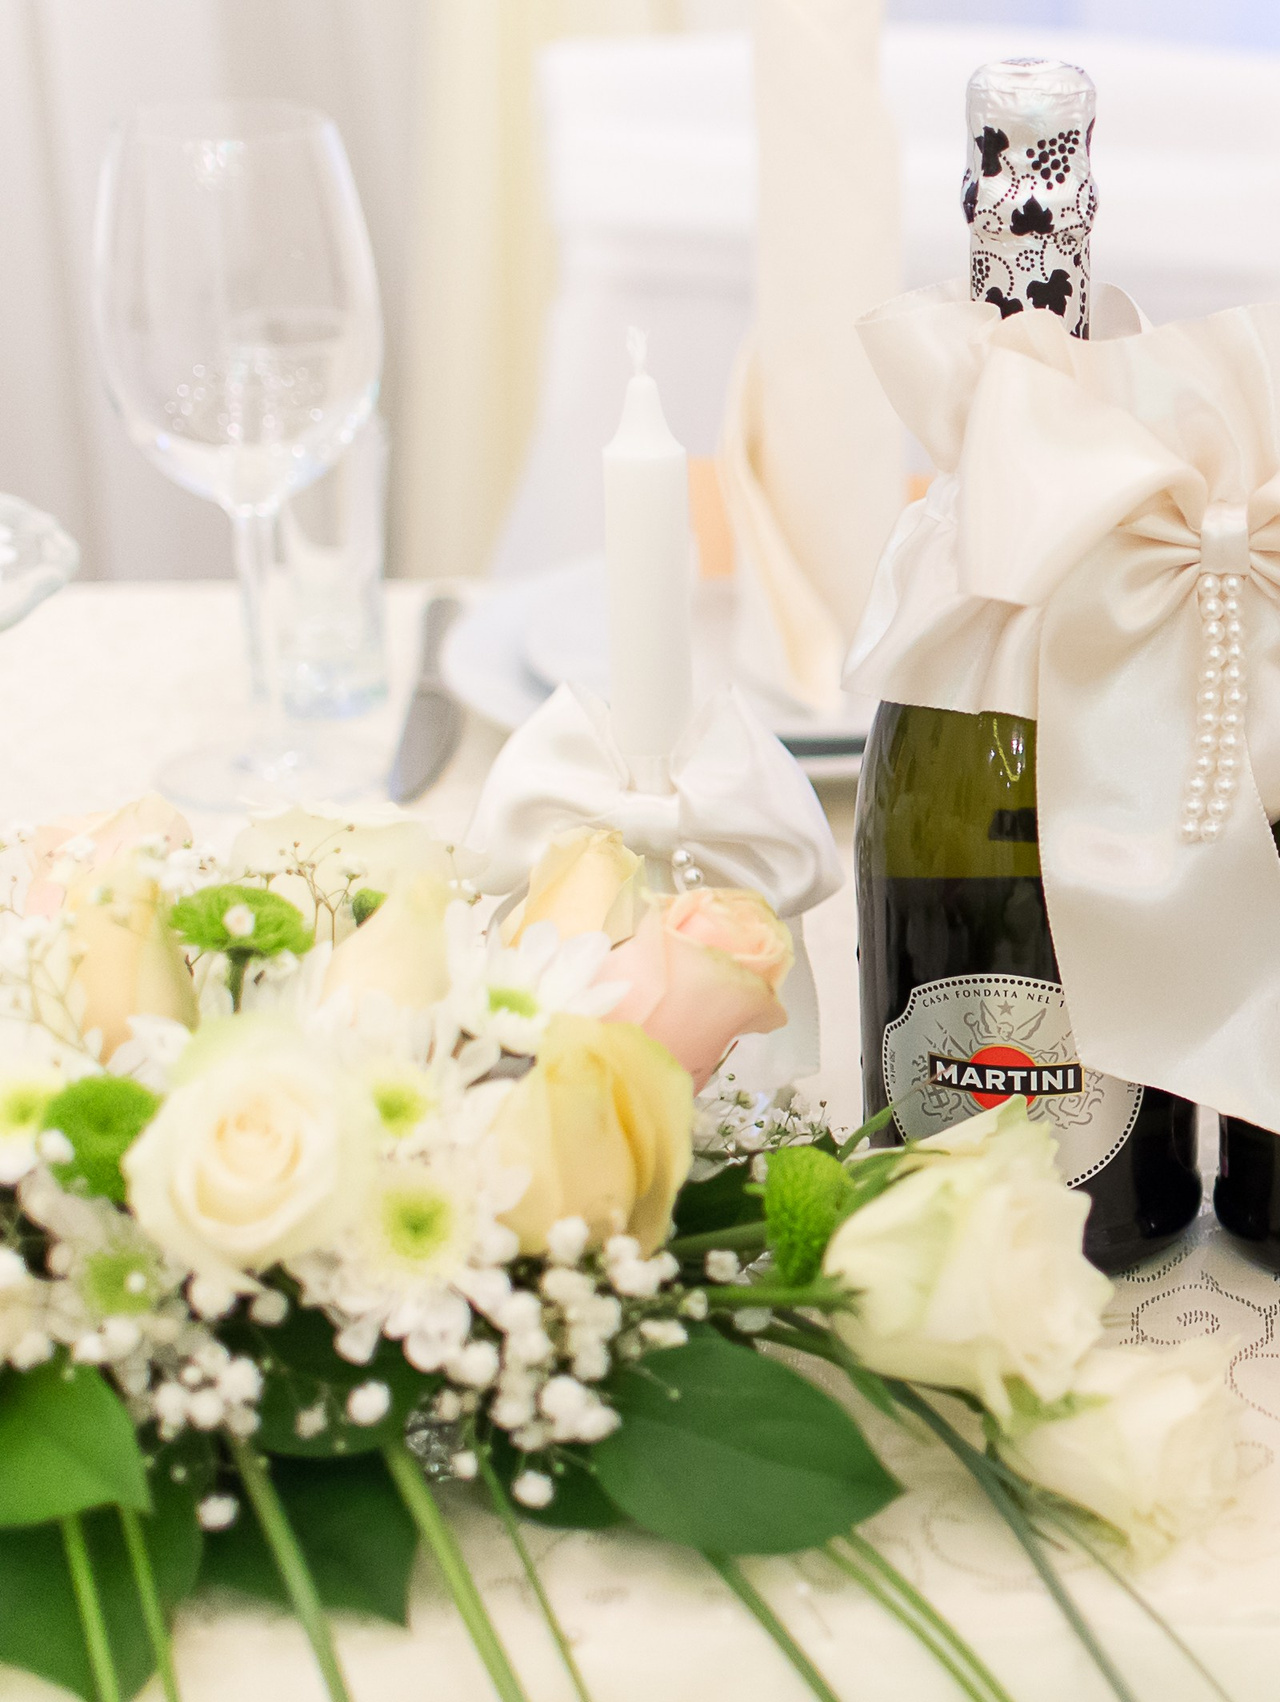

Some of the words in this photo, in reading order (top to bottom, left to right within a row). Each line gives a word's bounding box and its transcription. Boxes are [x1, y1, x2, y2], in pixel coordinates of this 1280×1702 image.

[922, 993, 950, 1008] CASA
[955, 988, 1018, 999] FONDATA
[1026, 992, 1051, 1005] NEL
[936, 1060, 1075, 1091] MARTINI
